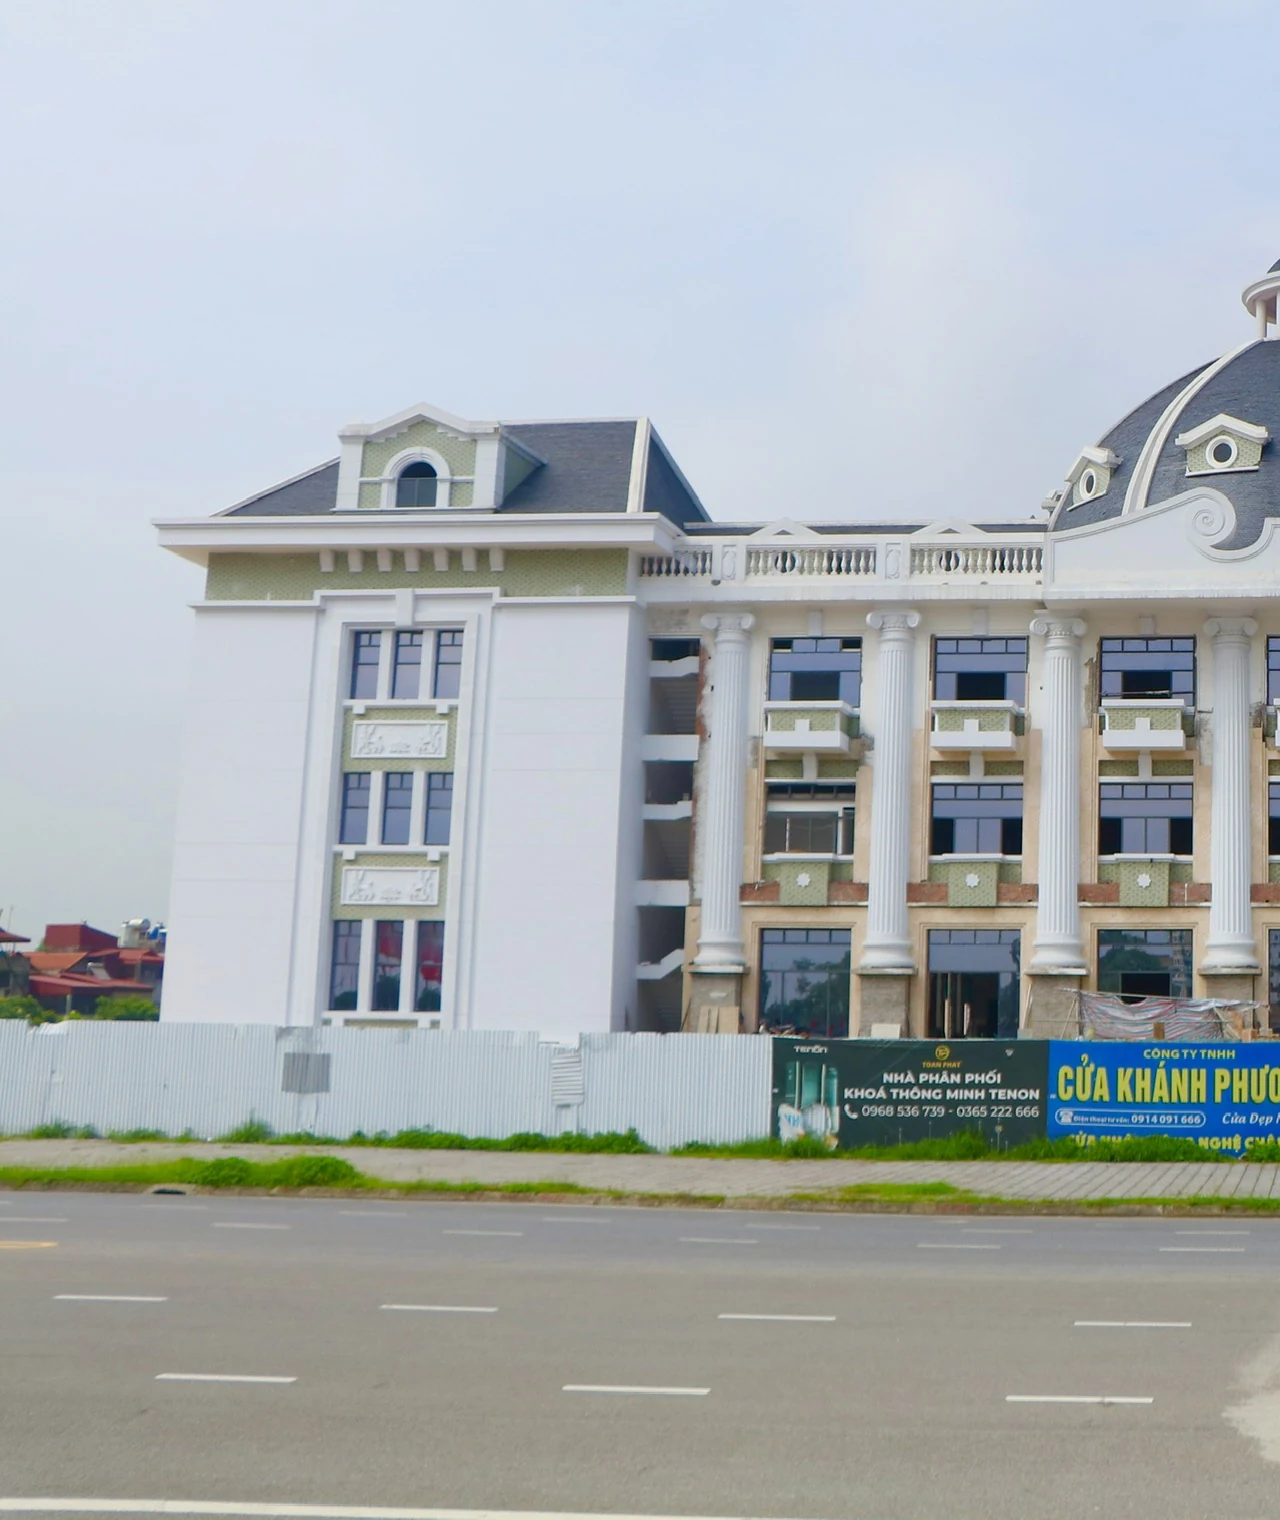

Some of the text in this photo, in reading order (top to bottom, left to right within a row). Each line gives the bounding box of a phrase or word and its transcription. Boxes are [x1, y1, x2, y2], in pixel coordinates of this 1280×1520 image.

[1143, 1048, 1236, 1059] CÔNG TY TNHH
[883, 1069, 1001, 1084] NHÀ PHÂN PHỐI
[1058, 1053, 1110, 1102] CỬA
[1117, 1061, 1207, 1103] KHÁNH
[844, 1086, 1040, 1100] KHOÁ THÔNG MINH TENON
[862, 1105, 894, 1118] 0968
[897, 1105, 919, 1118] 536
[923, 1105, 945, 1118] 739
[957, 1105, 987, 1118] 0365
[990, 1105, 1012, 1118] 222
[1015, 1105, 1040, 1118] 666
[1131, 1114, 1158, 1124] 0914
[1159, 1114, 1179, 1124] 091
[1181, 1115, 1200, 1124] 666
[1222, 1112, 1247, 1124] Cửa
[1249, 1112, 1273, 1126] Đẹp
[1198, 1133, 1241, 1153] NGHỆ
